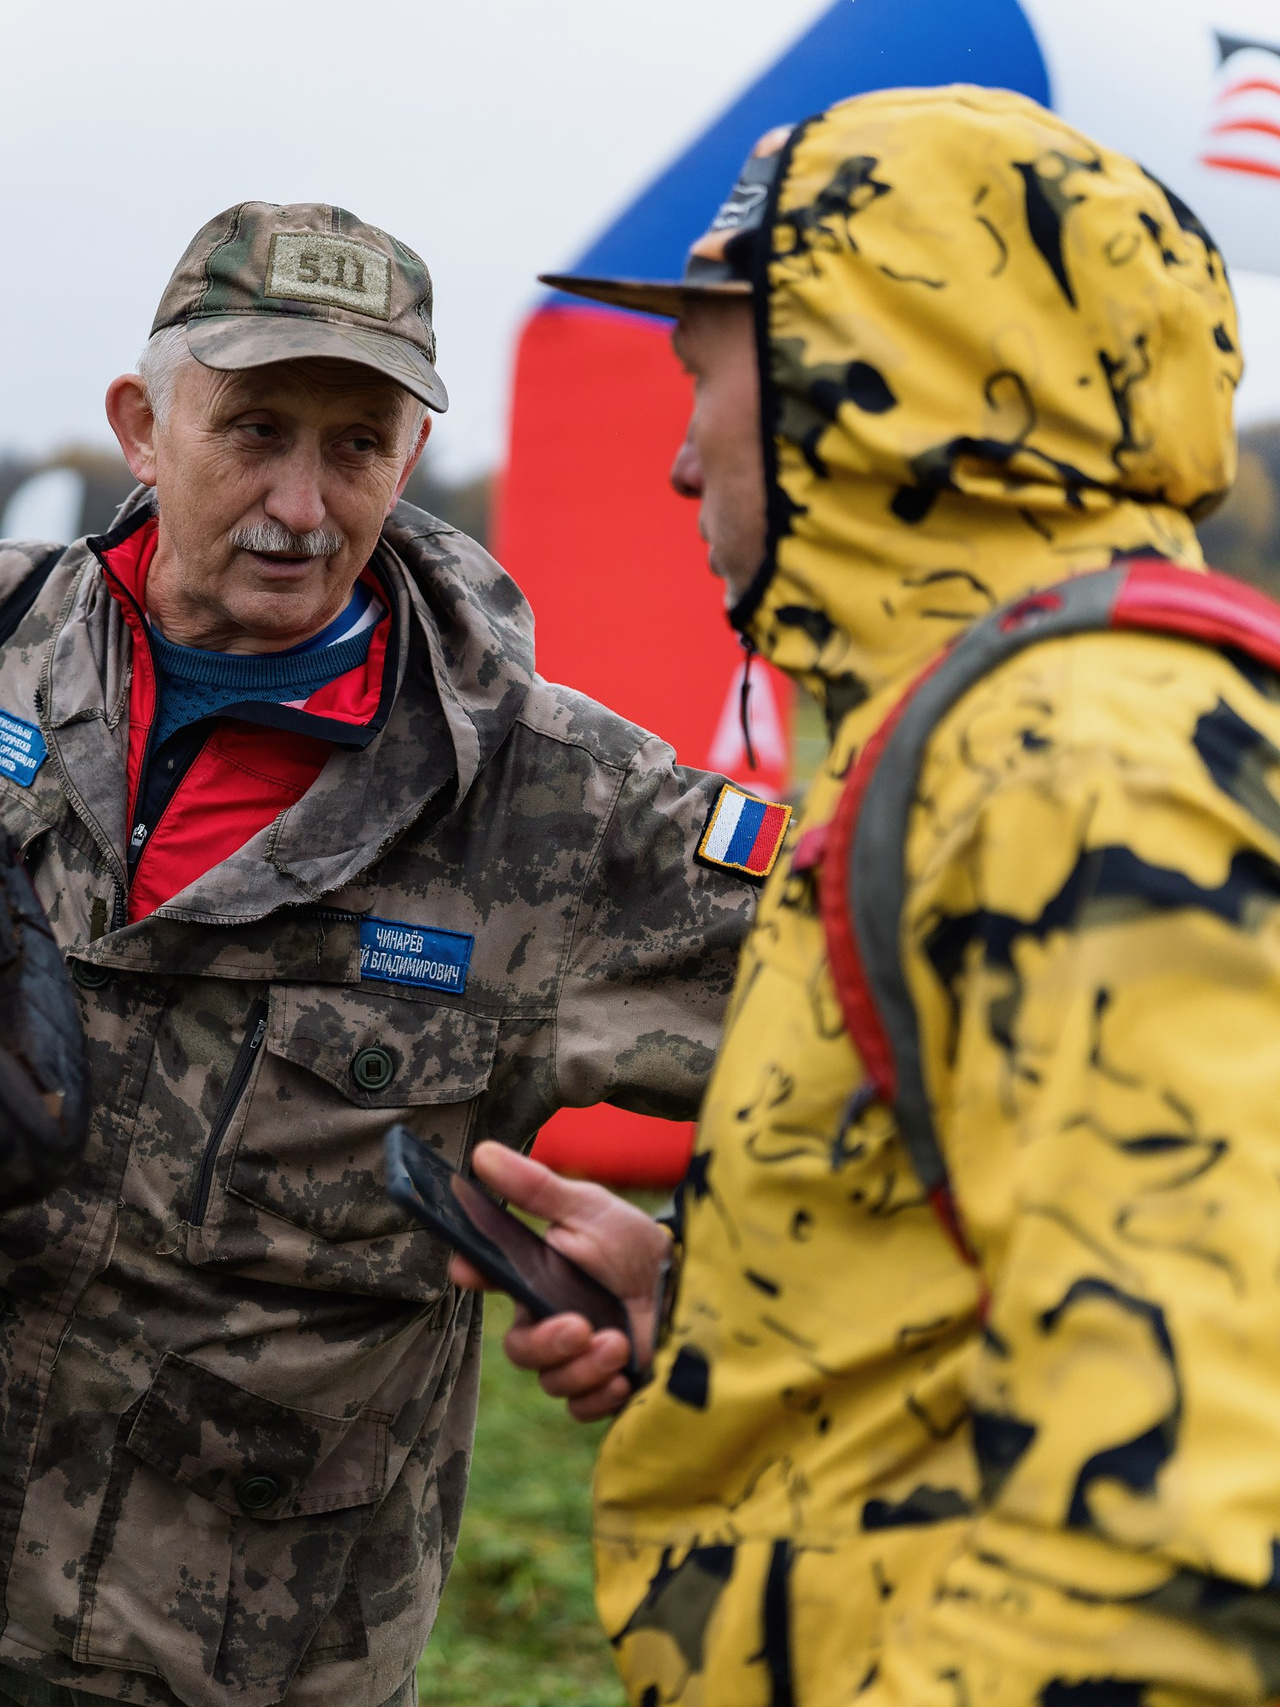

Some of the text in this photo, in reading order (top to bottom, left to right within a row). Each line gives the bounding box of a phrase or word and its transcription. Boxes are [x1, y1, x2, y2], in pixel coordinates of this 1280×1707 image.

[298, 252, 367, 293] 5.11
[376, 928, 424, 953] ЧИНАРЁВ
[370, 951, 460, 985] ВЛАДИМИРОВИЧ
